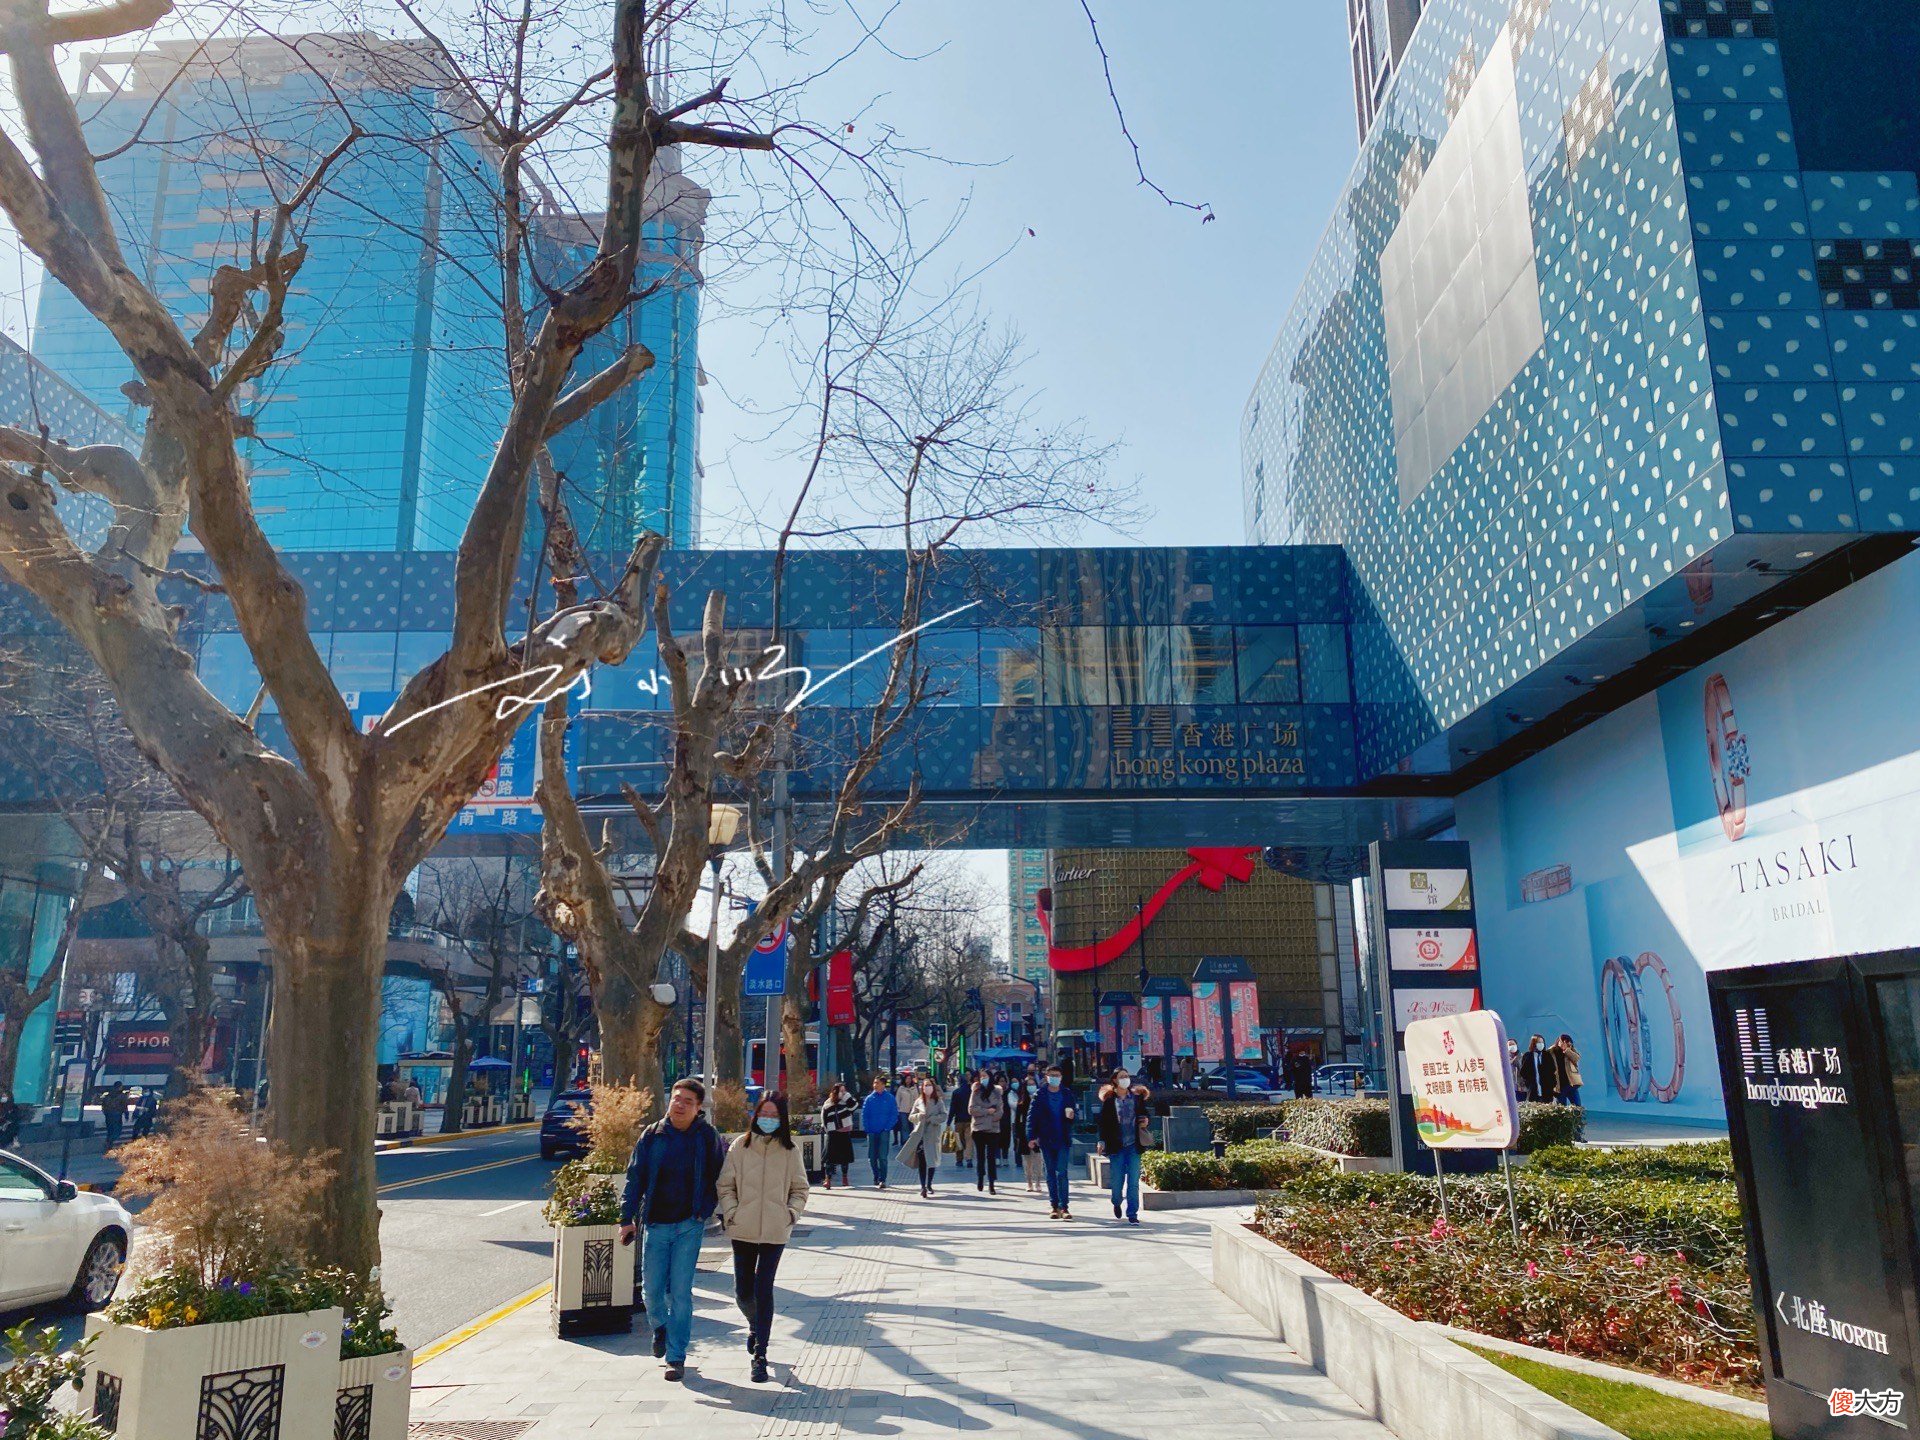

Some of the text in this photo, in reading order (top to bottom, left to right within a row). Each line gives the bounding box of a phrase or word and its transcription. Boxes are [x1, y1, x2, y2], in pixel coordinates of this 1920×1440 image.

[1181, 722, 1298, 748] 香港广场
[1053, 864, 1096, 883] Cartier
[1731, 834, 1858, 893] TASAKI
[1772, 899, 1825, 921] BRIDAL
[748, 979, 782, 990] 淡水路口
[1422, 1058, 1486, 1077] 爱国卫生 人人参与
[1776, 1047, 1842, 1074] 香港广场
[1425, 1077, 1489, 1095] 文明健康 有你有我
[1790, 1295, 1890, 1355] 北座 NORTH
